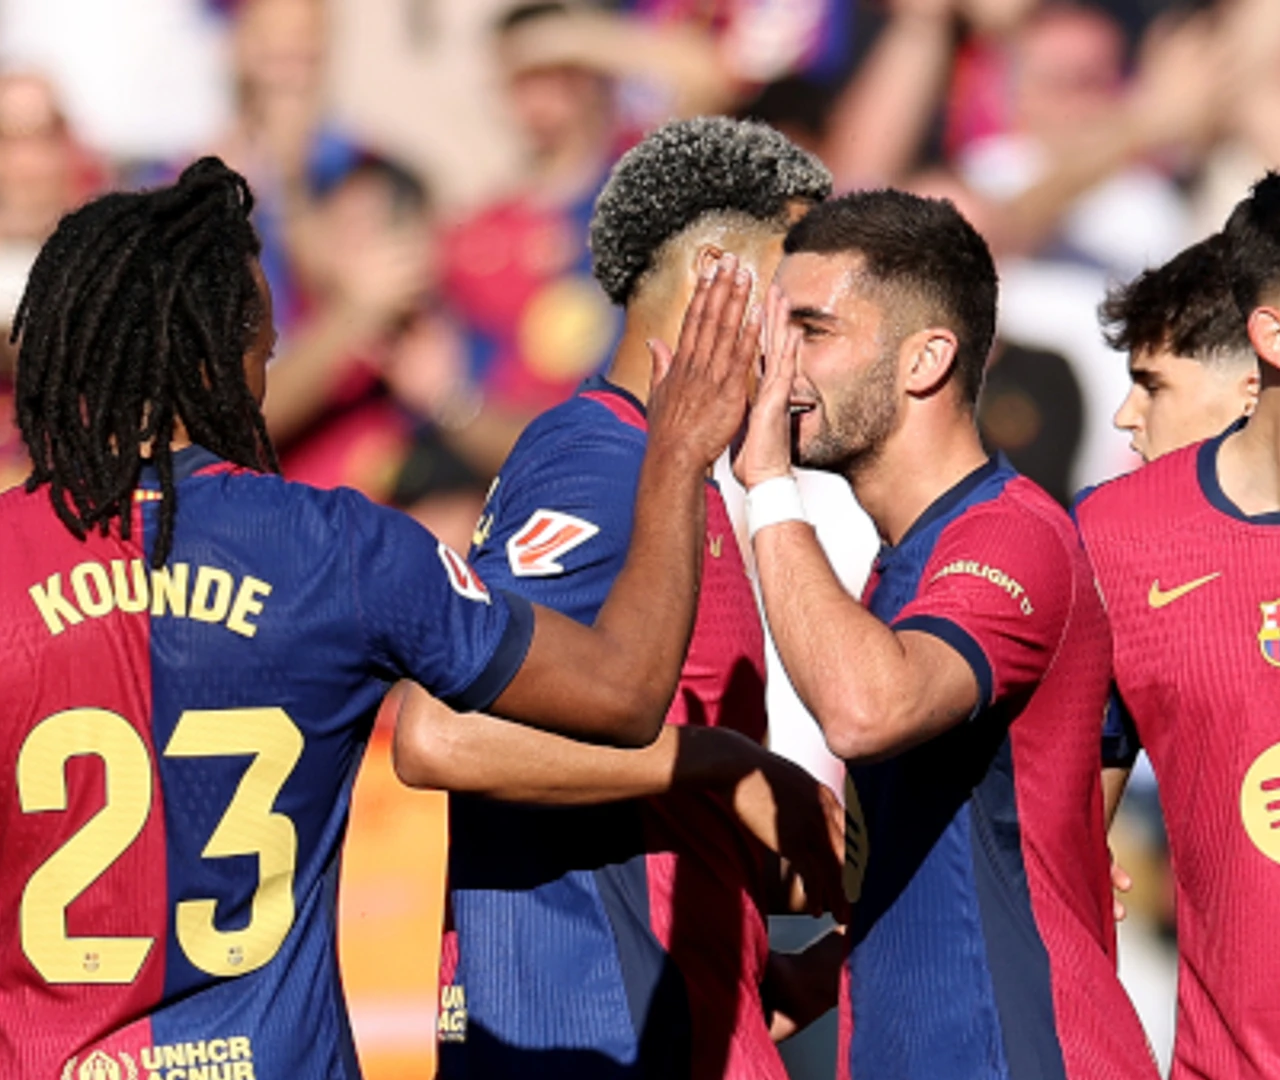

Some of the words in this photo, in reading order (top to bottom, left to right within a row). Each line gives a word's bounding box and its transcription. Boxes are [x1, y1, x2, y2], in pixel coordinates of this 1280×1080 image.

[29, 558, 272, 637] KOUNDE
[16, 706, 305, 984] 23
[140, 1036, 252, 1071] UNHCR
